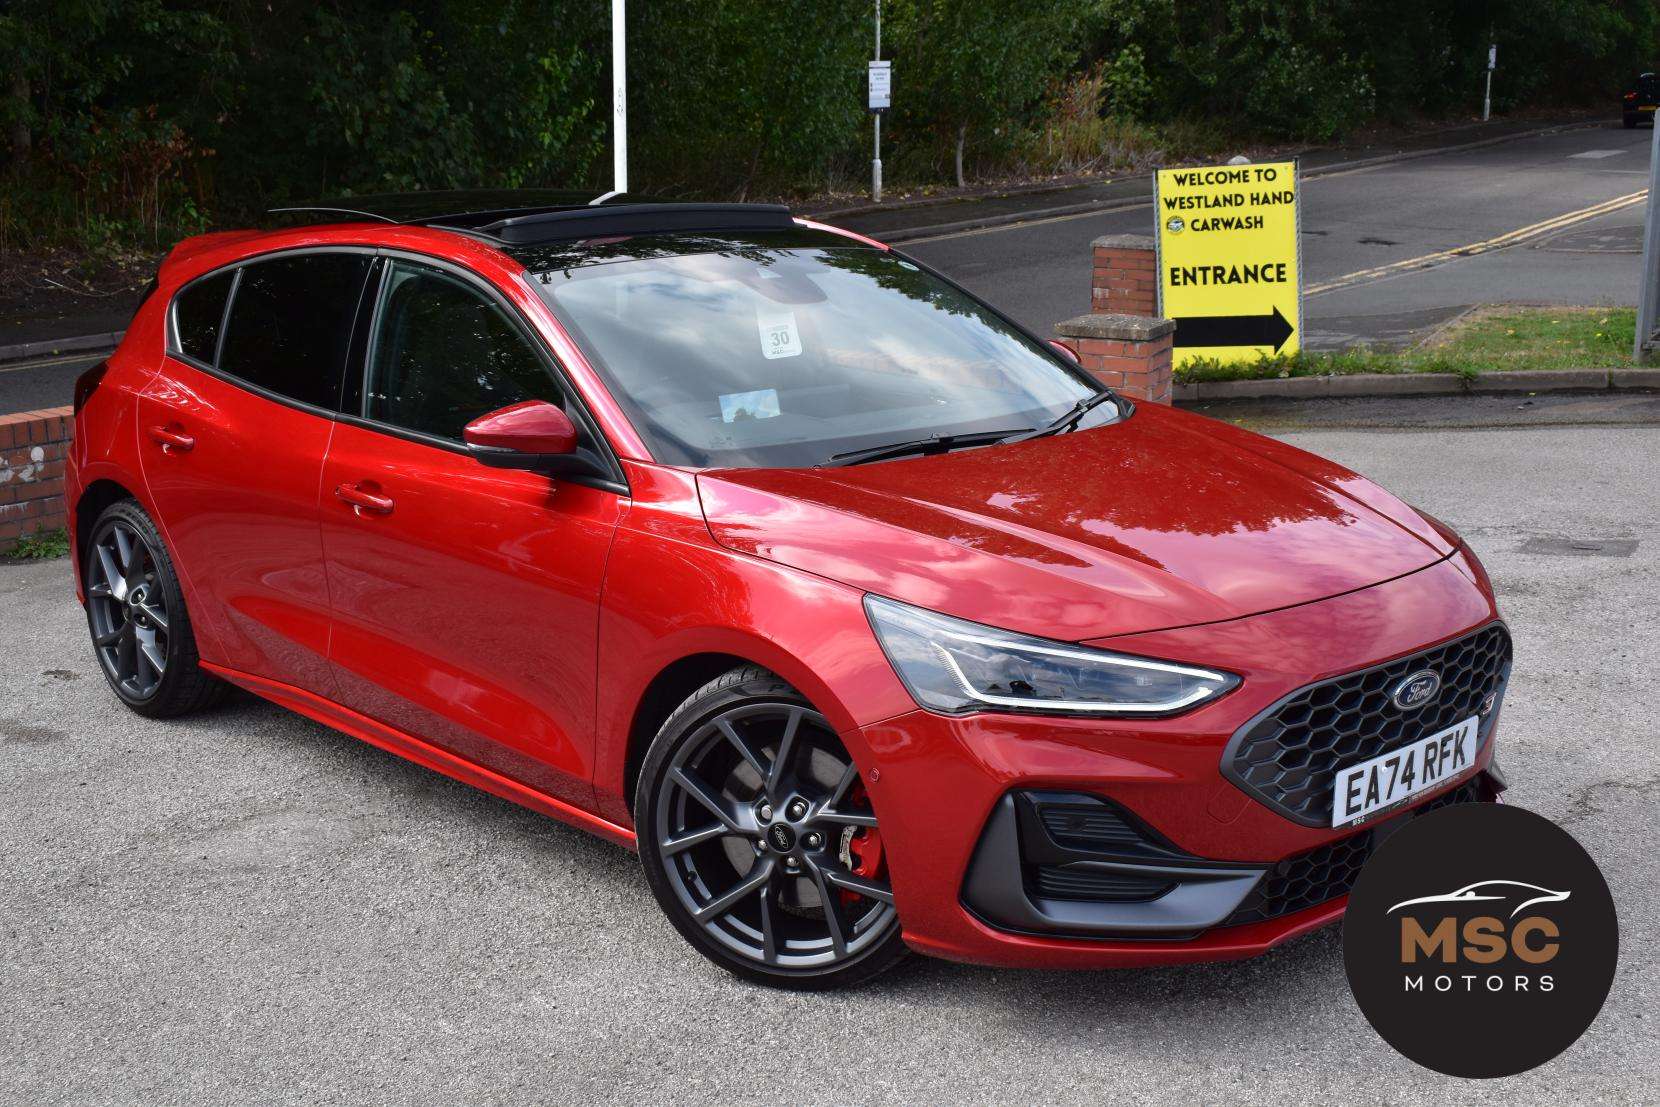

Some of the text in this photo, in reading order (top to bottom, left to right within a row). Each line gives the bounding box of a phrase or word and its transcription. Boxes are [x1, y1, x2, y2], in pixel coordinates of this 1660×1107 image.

[1173, 168, 1277, 187] WELCOME TO
[1163, 190, 1294, 210] WESTLAND HAND
[1190, 215, 1264, 231] CARWASH
[1170, 263, 1287, 286] ENTRANCE
[770, 331, 790, 346] 30
[1407, 680, 1433, 703] Ford
[1345, 726, 1468, 817] EA74 RFK
